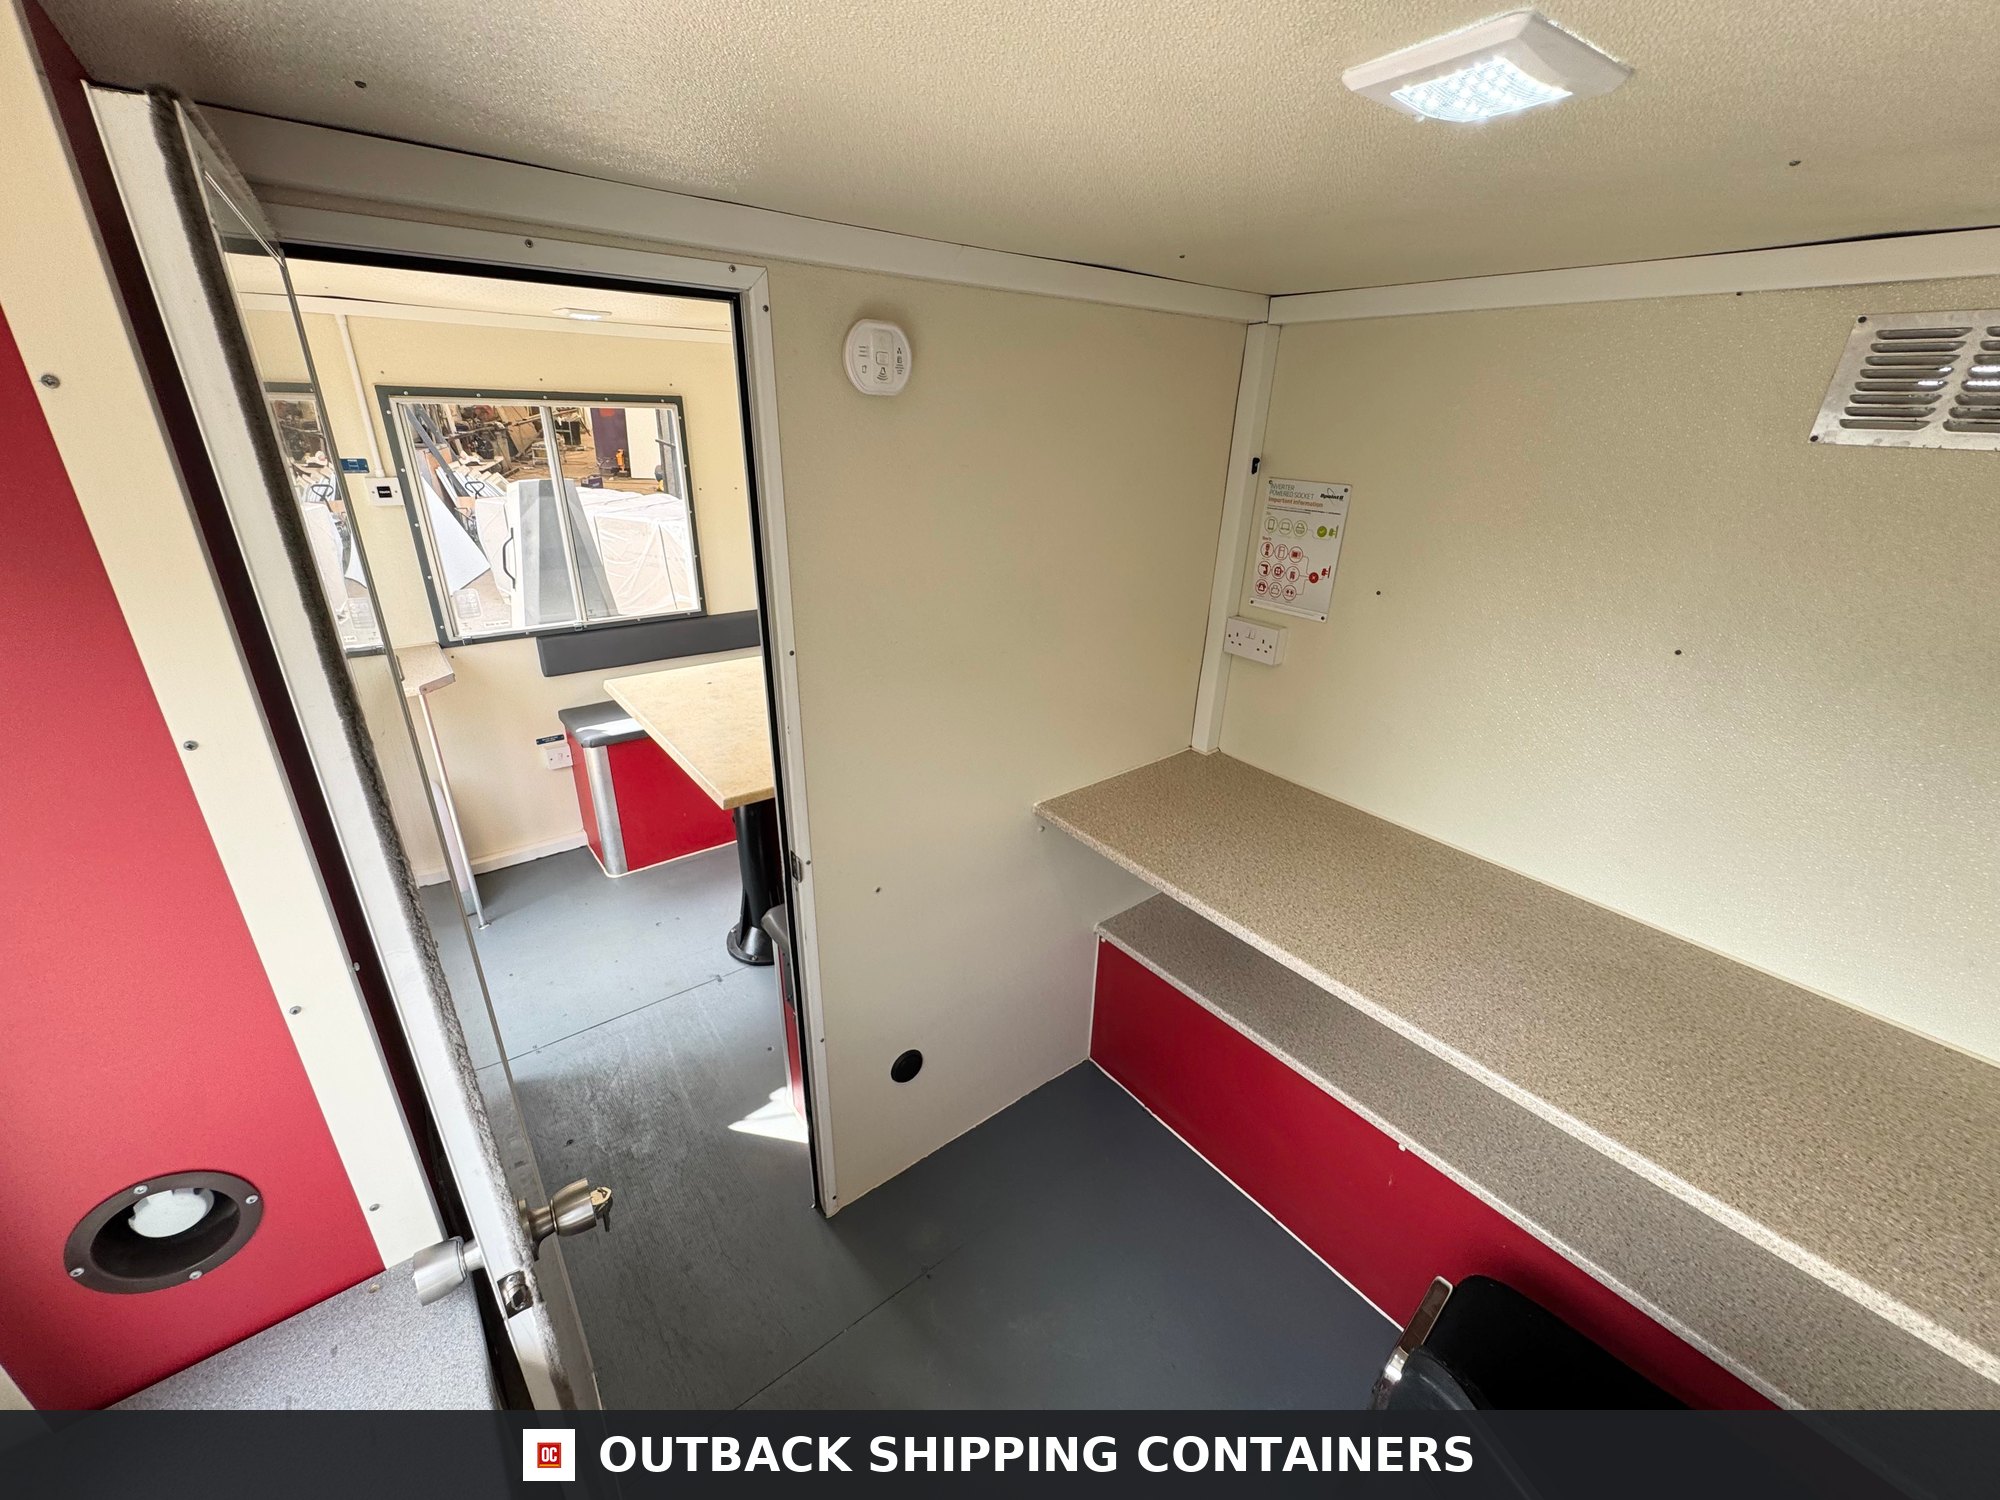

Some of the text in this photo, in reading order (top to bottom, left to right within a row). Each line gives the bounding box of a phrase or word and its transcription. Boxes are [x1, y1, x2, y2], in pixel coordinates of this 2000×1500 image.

[1269, 490, 1293, 498] POWERED
[1269, 496, 1323, 507] Important information
